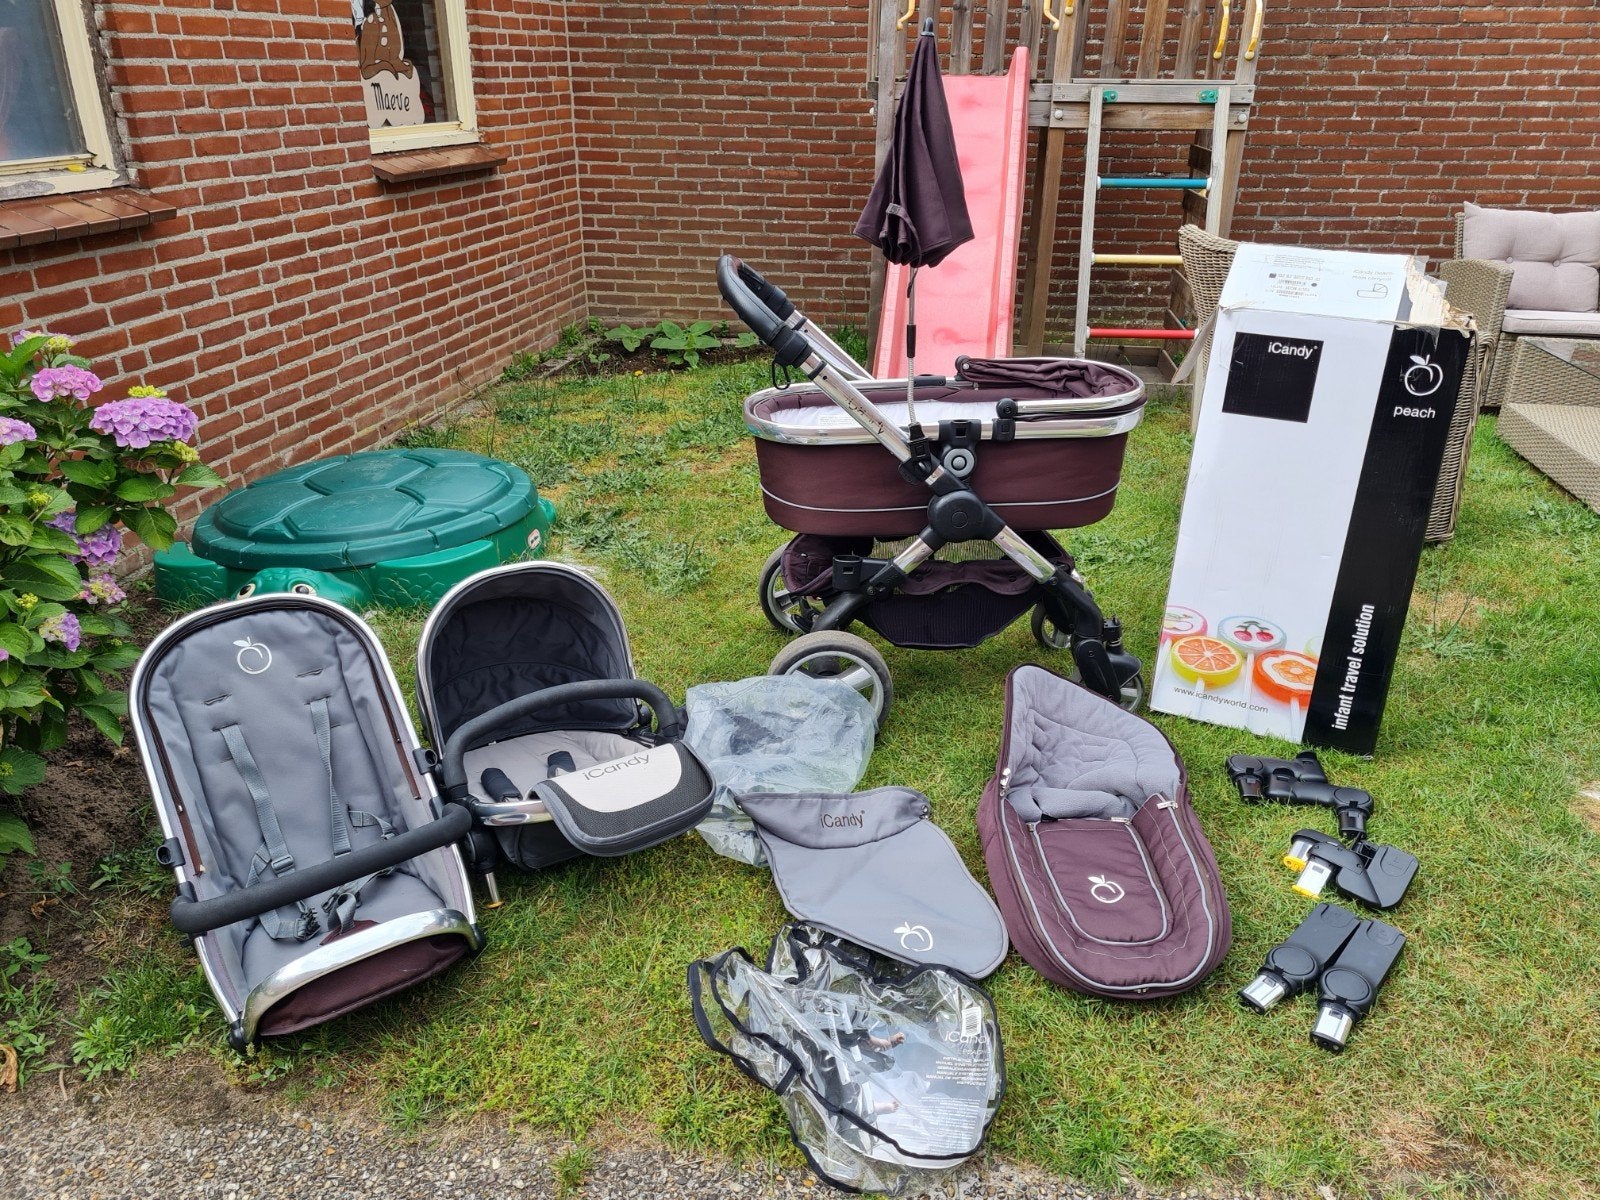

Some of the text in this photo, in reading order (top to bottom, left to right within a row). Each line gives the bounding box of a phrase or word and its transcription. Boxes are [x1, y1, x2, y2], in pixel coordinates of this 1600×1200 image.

[371, 82, 410, 112] Maeve
[1393, 405, 1436, 419] peach
[1331, 603, 1376, 731] infant travel solution
[1173, 686, 1269, 714] www.icandyworld.com
[582, 753, 650, 781] iCandy
